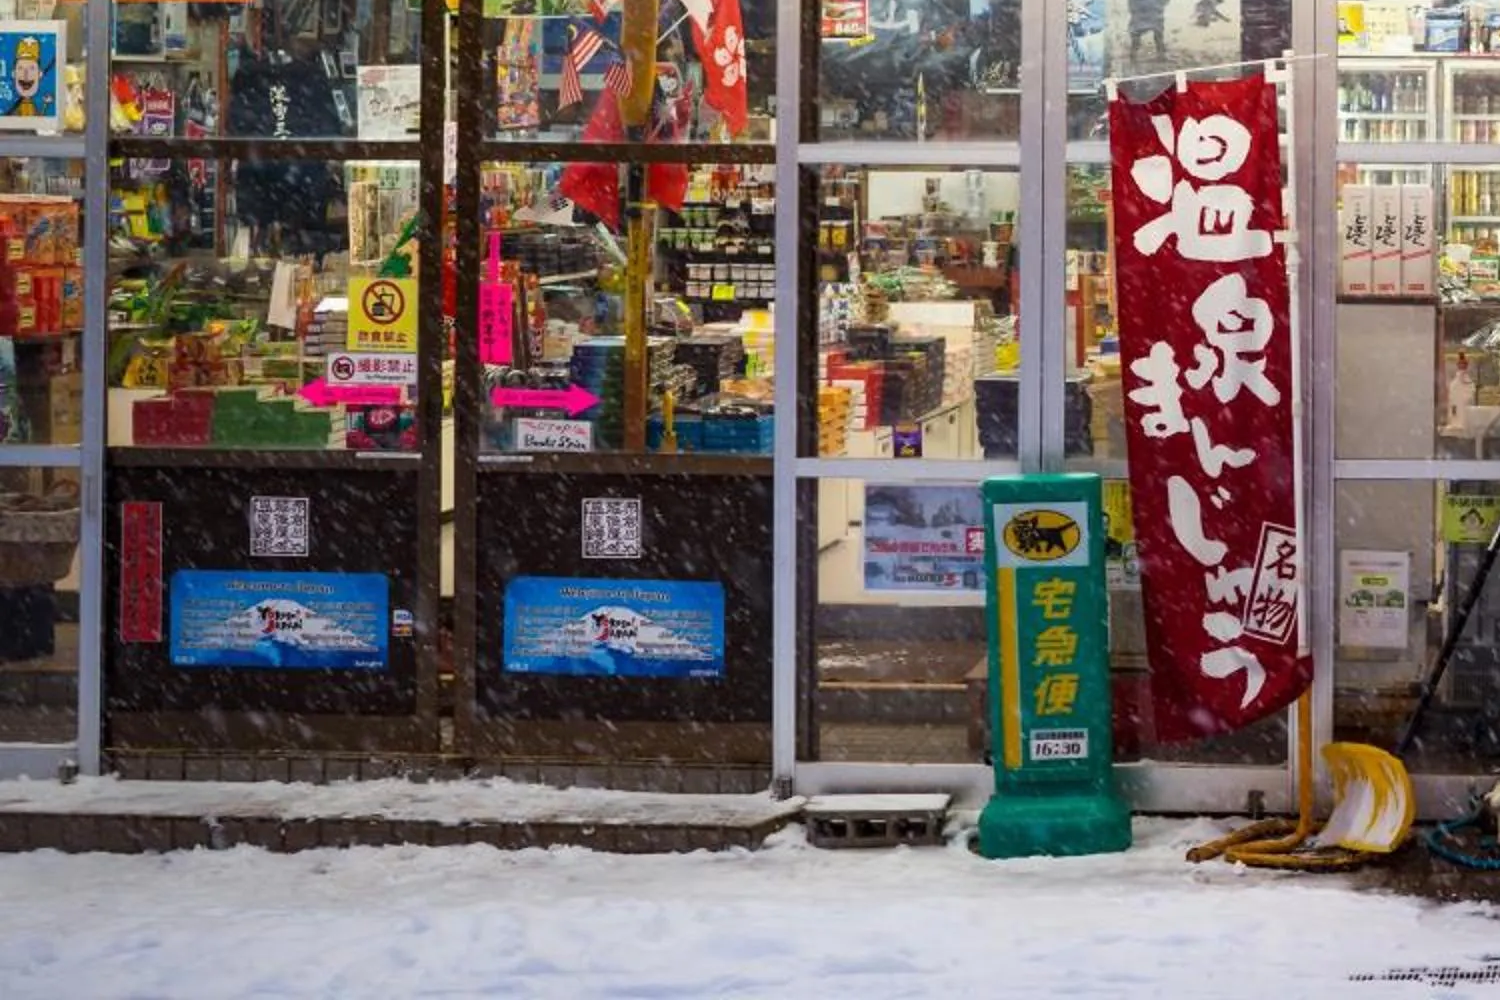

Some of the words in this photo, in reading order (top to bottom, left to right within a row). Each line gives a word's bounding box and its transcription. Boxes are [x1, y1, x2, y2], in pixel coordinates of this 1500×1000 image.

[358, 358, 414, 372] 撮影禁止
[1252, 541, 1297, 630] 名物
[1031, 577, 1081, 716] 宅急便
[1034, 741, 1081, 756] 16:30
